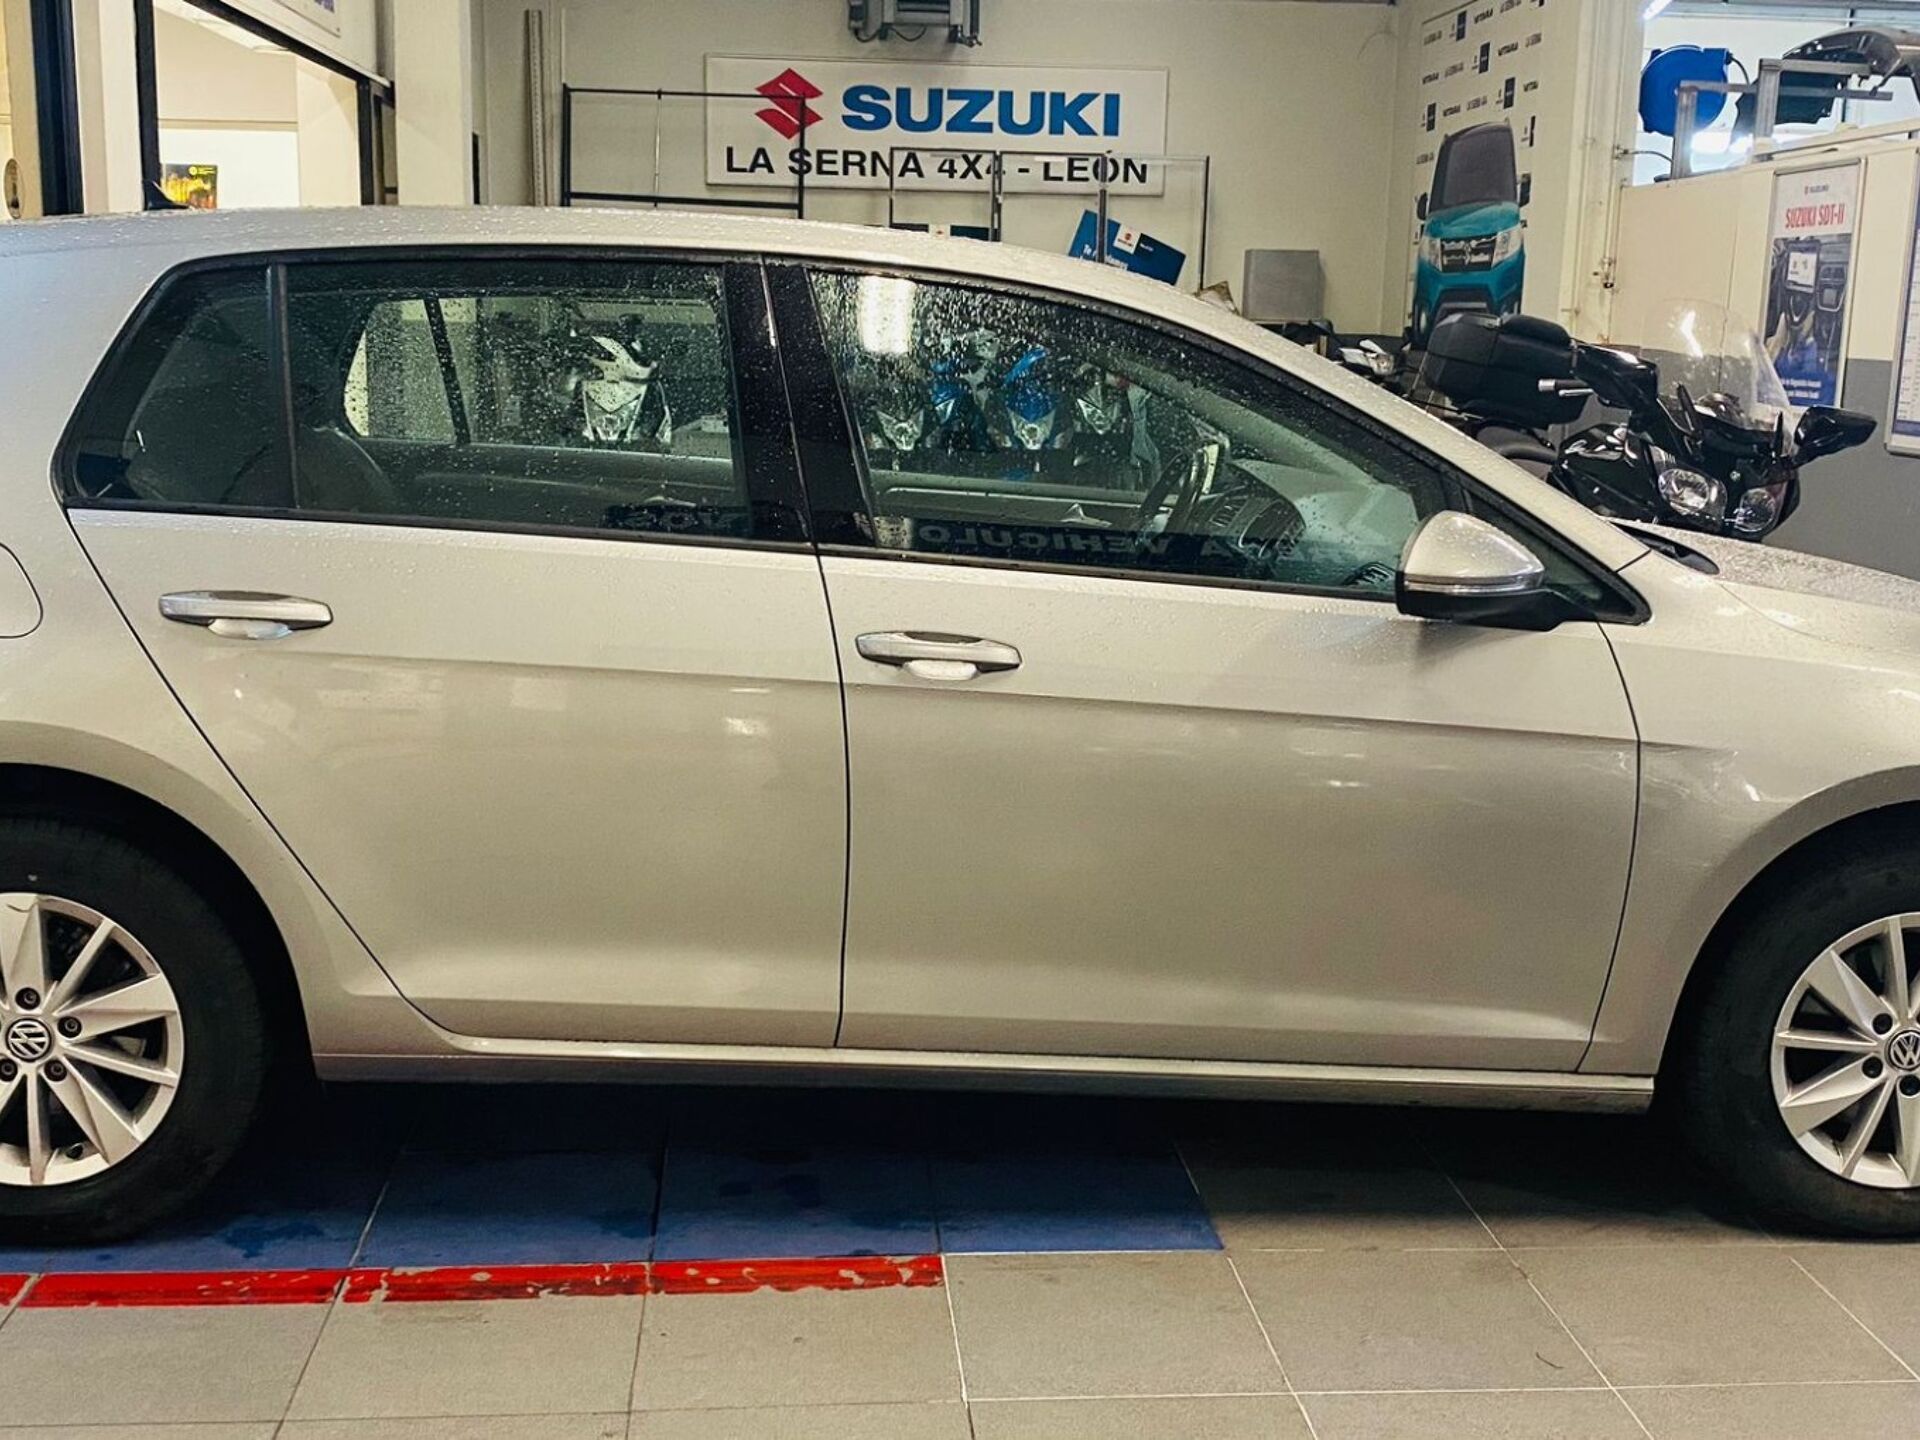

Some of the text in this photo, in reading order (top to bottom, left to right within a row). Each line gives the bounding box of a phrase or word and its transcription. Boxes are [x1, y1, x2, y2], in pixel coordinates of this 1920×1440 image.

[841, 85, 1121, 137] SUZUKI
[726, 146, 775, 173] LA
[788, 147, 925, 178] SERNA
[1785, 206, 1817, 229] SUZUKI
